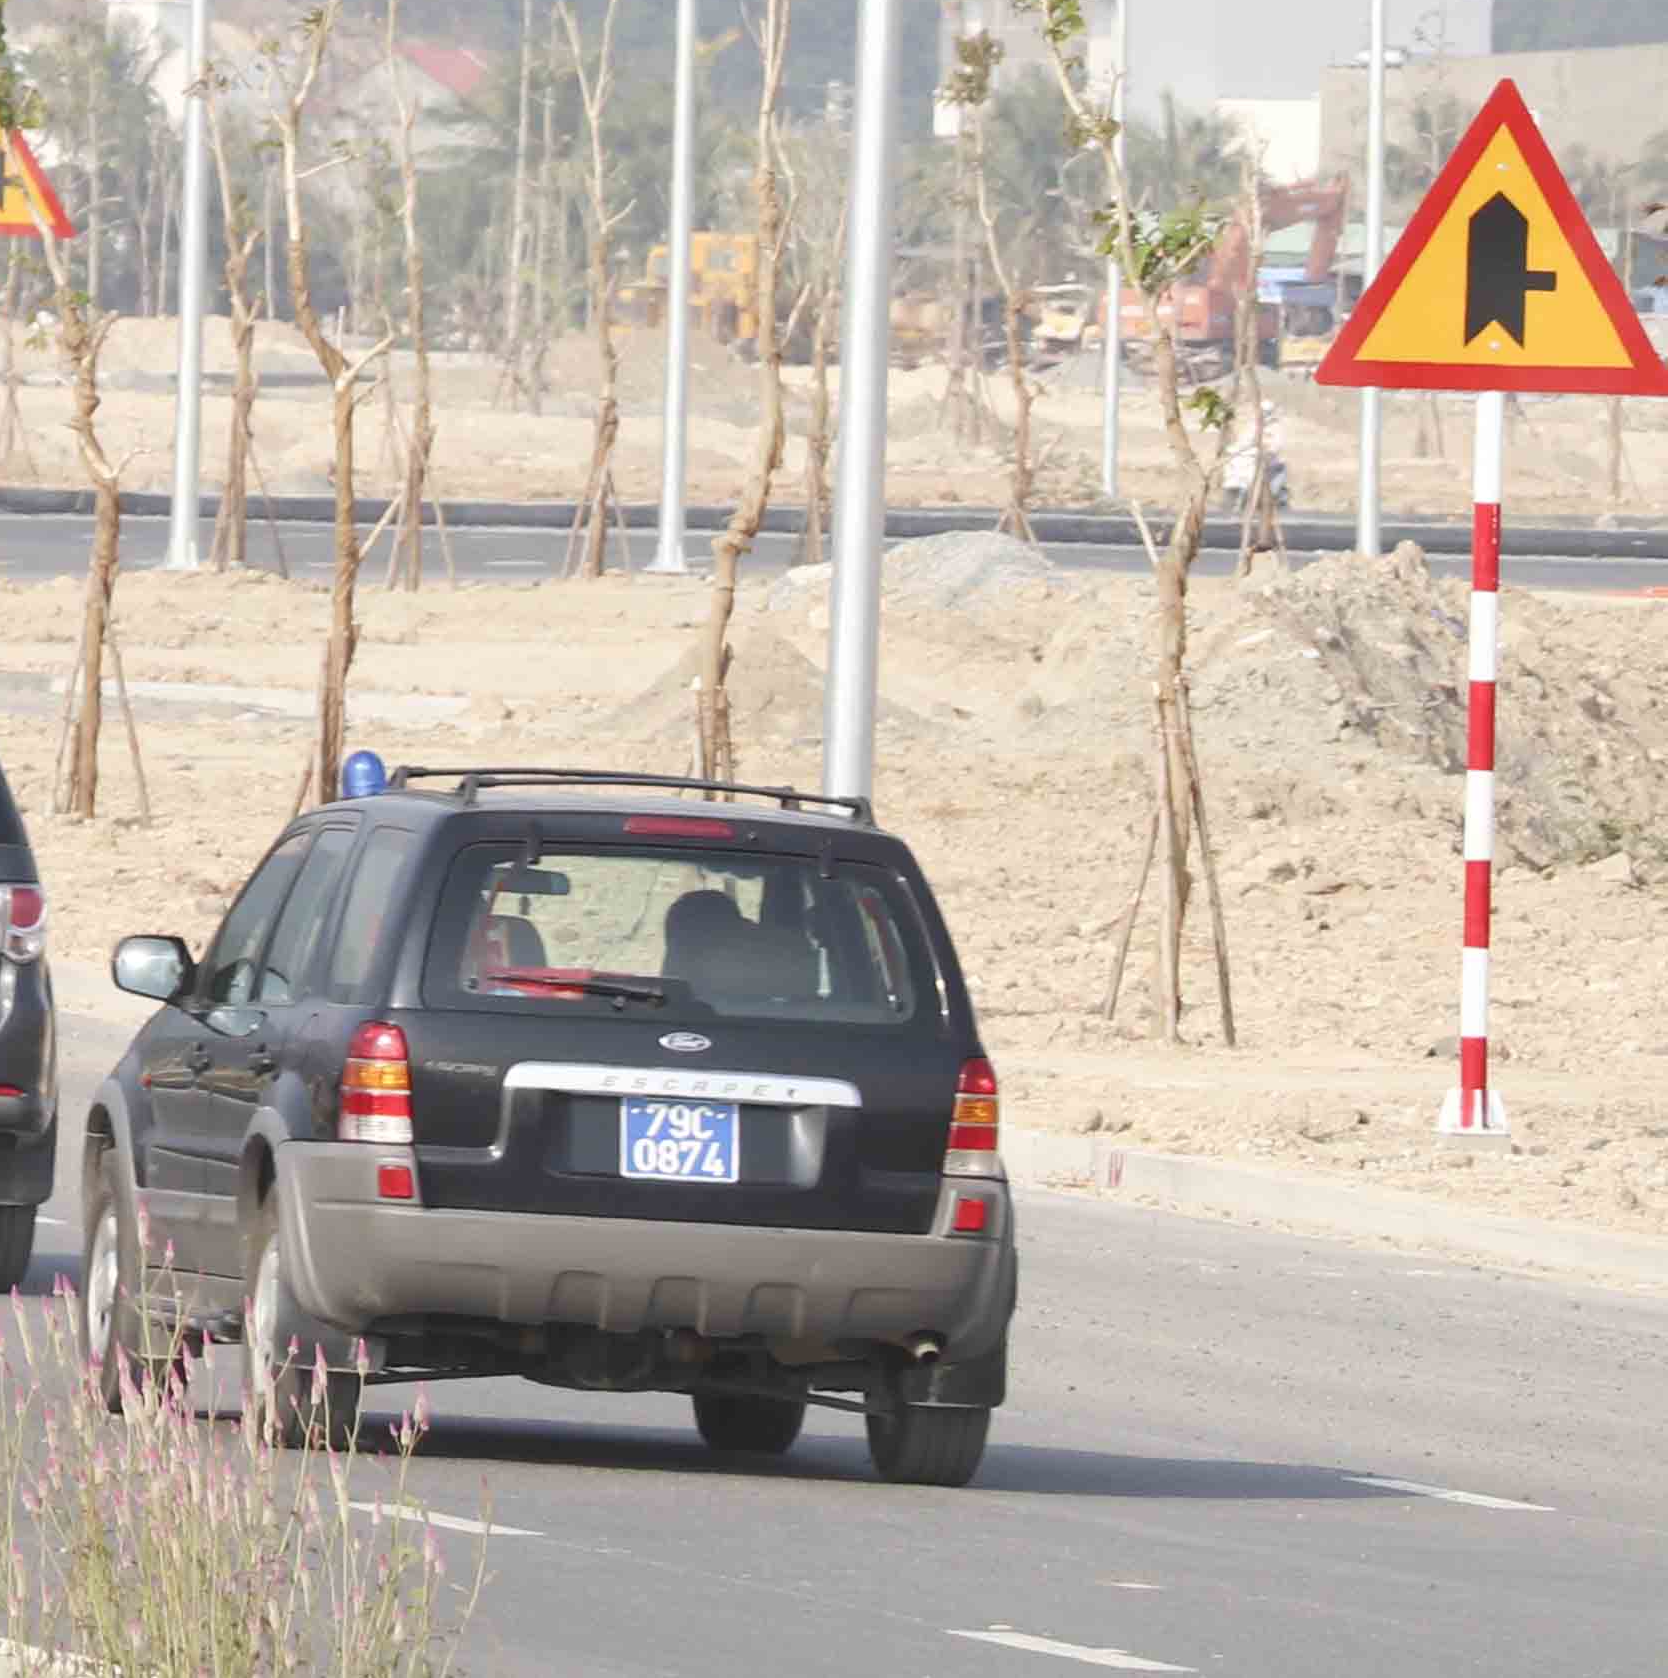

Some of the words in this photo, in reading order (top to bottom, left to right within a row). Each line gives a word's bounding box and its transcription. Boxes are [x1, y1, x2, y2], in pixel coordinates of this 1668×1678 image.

[600, 1075, 770, 1098] ESCAPE
[645, 1103, 715, 1140] 79C
[632, 1137, 727, 1177] 0874
